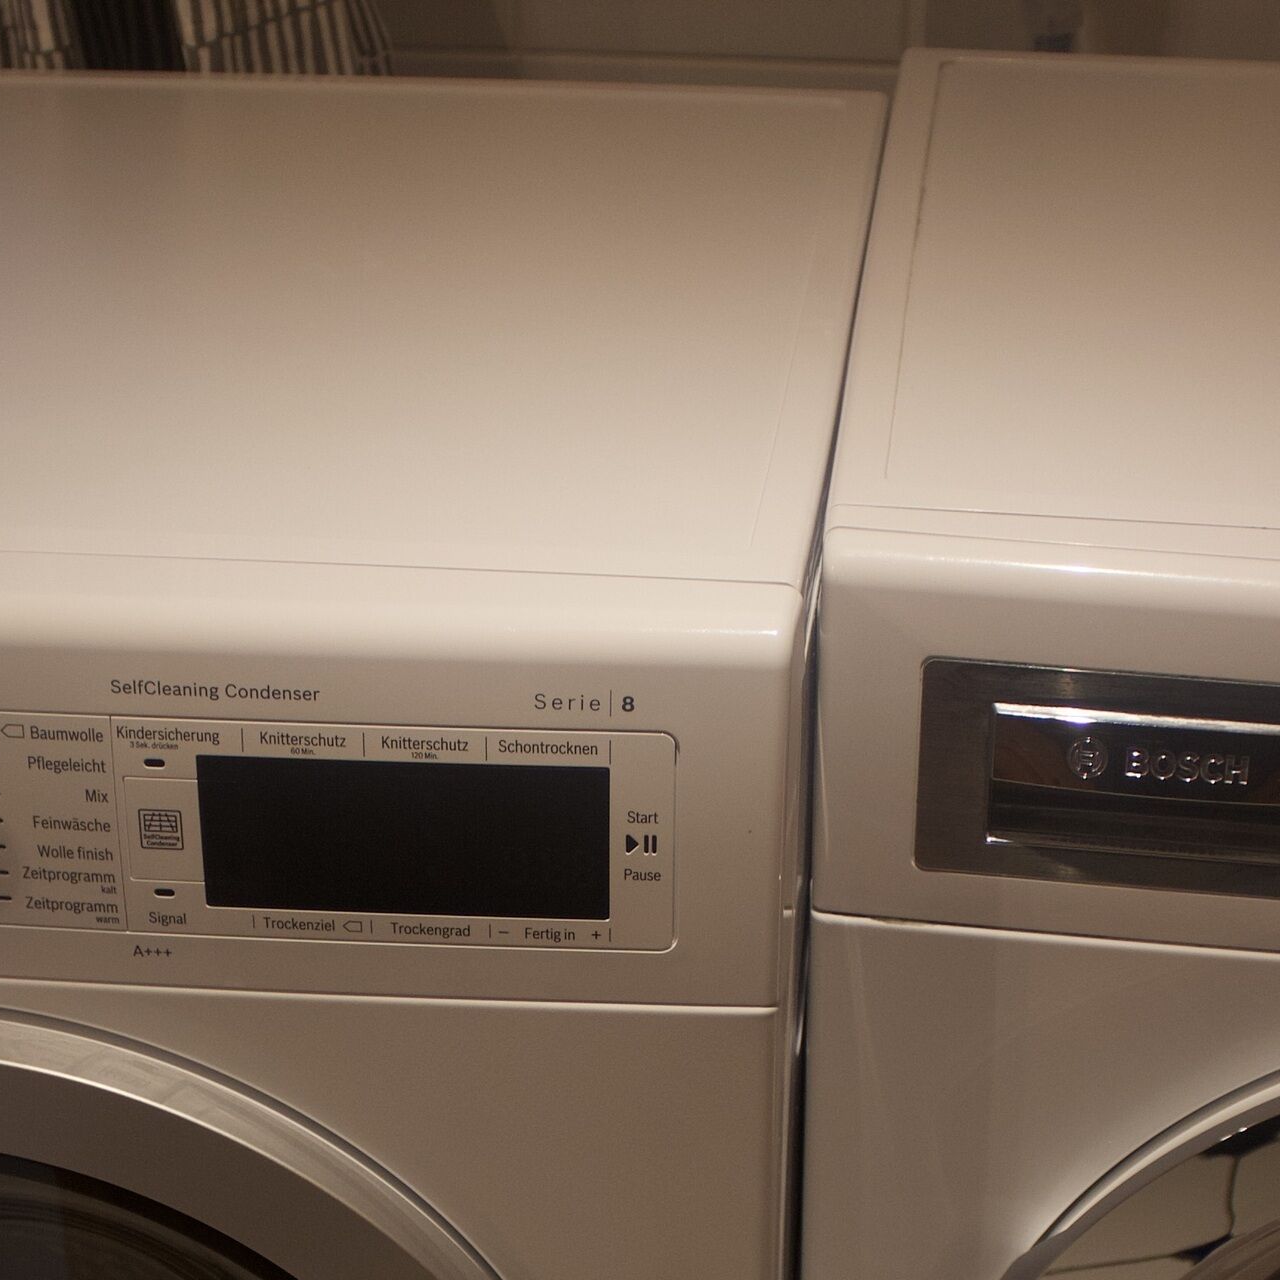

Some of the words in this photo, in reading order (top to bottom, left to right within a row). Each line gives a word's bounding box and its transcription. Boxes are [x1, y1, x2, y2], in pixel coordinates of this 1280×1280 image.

[110, 680, 219, 700] SelfCleaning
[225, 683, 320, 701] Condenser
[534, 693, 602, 712] Serie
[621, 696, 635, 712] 8
[30, 726, 104, 742] Baumwolle
[116, 726, 220, 745] Kindersicherung
[260, 731, 346, 748] Knitterschutz
[151, 741, 178, 750] drücken
[381, 735, 469, 752] Knitterschutz
[498, 739, 598, 755] Schontrocknen
[424, 752, 439, 760] Min.
[28, 756, 106, 774] Pflegeleicht
[1125, 746, 1250, 786] BOSCH
[85, 789, 109, 803] Mix
[33, 815, 111, 832] Feinwäsche
[627, 811, 659, 825] Start
[37, 845, 74, 860] Wolle
[77, 847, 114, 861] finish
[23, 866, 116, 884] Zeitprogramm
[623, 868, 662, 882] Pause
[101, 886, 117, 894] kalt
[26, 896, 119, 914] Zeitprogramm
[96, 916, 120, 924] warm
[149, 912, 187, 926] Signal
[263, 917, 335, 932] Trockenziel
[390, 922, 470, 938] Trockengrad
[525, 927, 561, 942] Fertig
[564, 928, 576, 941] in
[133, 945, 172, 957] A+++
